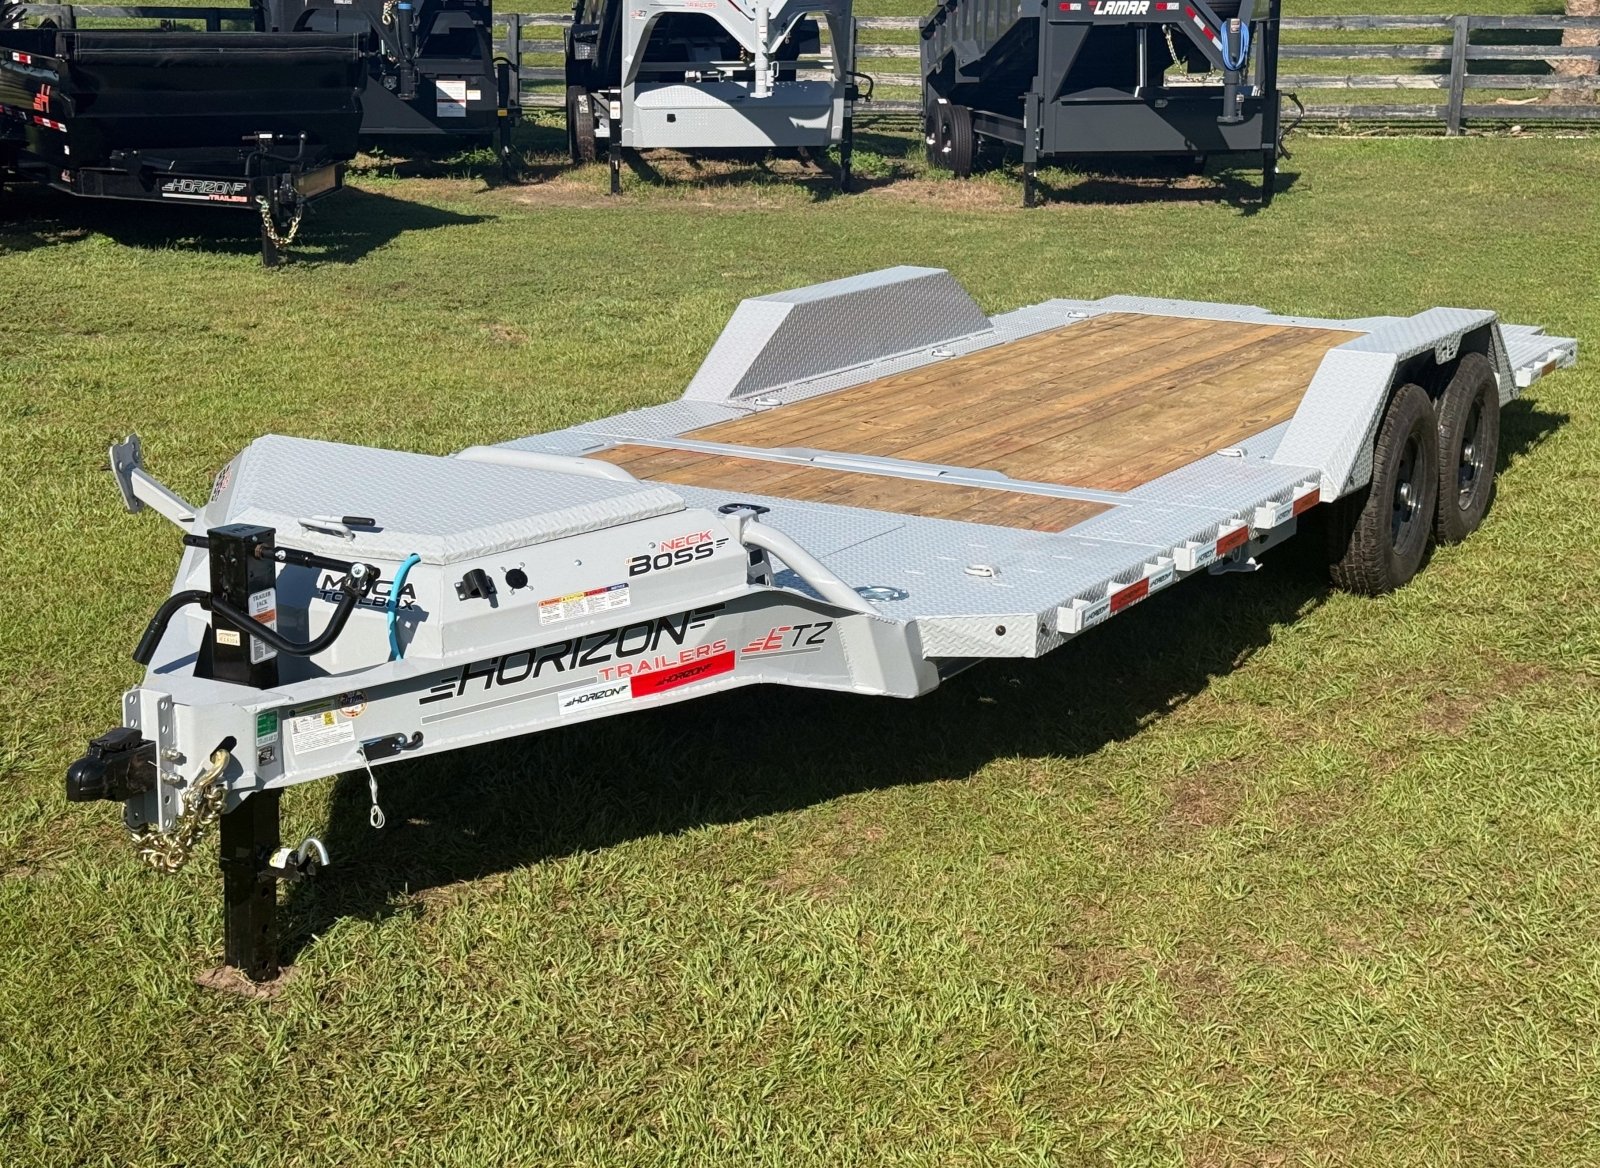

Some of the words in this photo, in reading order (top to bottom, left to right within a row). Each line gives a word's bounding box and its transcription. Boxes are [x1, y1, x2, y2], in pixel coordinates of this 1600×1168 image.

[1094, 1, 1150, 15] LAMAR
[170, 179, 239, 195] HORIZON
[660, 529, 713, 552] NECK
[629, 541, 715, 577] BOSS
[252, 590, 272, 602] TRAILER
[321, 574, 416, 600] MGA
[256, 599, 268, 608] JACK
[320, 590, 416, 611] TOLBX
[455, 607, 700, 697] HORIZON
[599, 639, 728, 681] TRAILERS
[660, 663, 709, 686] HORIZON
[569, 686, 625, 707] HORIZON
